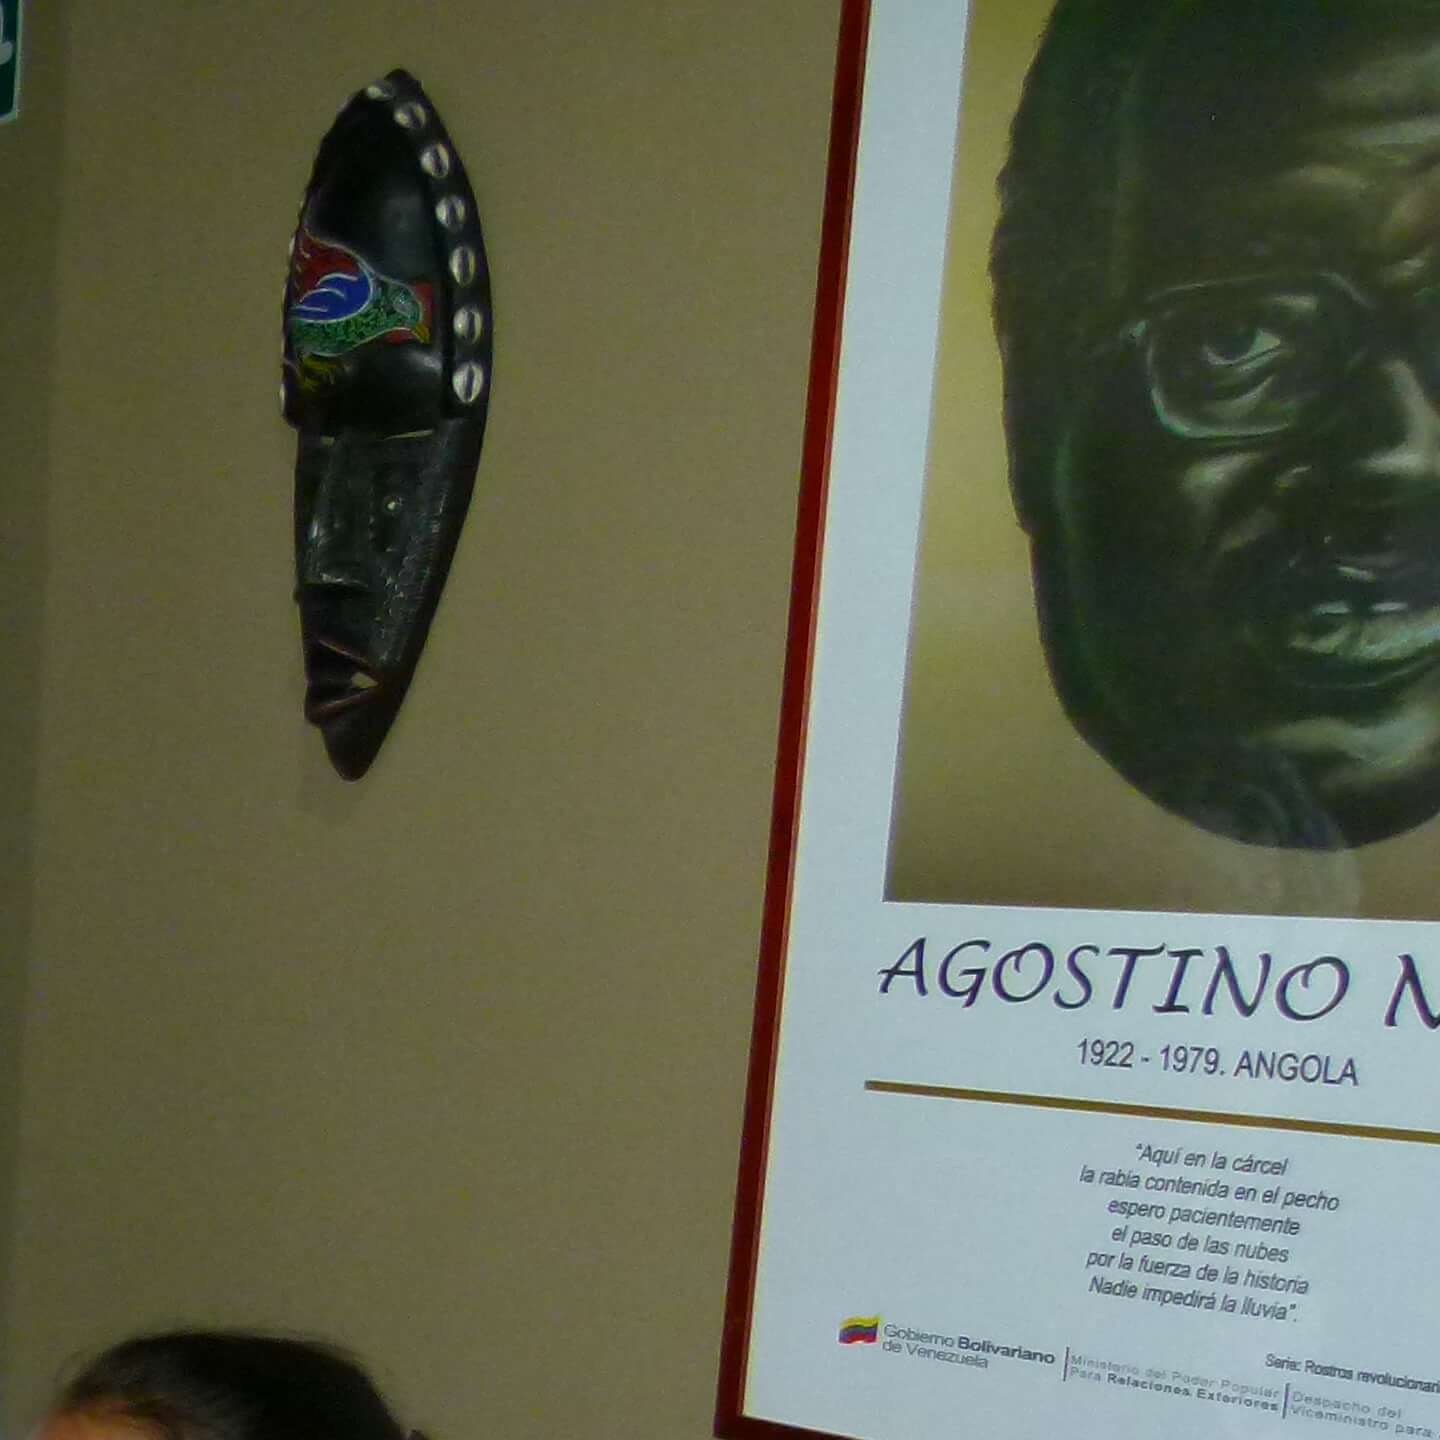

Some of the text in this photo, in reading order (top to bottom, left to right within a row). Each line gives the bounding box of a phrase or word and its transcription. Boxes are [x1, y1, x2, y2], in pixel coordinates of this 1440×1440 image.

[877, 936, 1352, 1021] AGOSTINO
[1077, 1038, 1135, 1069] 1922
[1160, 1044, 1225, 1076] 1979.
[1233, 1050, 1360, 1086] ANGOLA
[1183, 1150, 1206, 1168] en
[1210, 1151, 1227, 1170] la
[1231, 1154, 1289, 1177] cárcel
[1079, 1165, 1340, 1213] la rabia contenida en el pecho
[1107, 1198, 1301, 1236] espero pacientemente
[1111, 1225, 1290, 1264] el paso de las nubes
[1085, 1251, 1310, 1296] por la fuerza de la historia
[1088, 1275, 1138, 1299] Nadie
[1142, 1284, 1216, 1311] impedirá
[1220, 1293, 1237, 1314] la
[882, 1340, 989, 1369] de Venezuela
[883, 1323, 1056, 1365] Gobierno Bolivariano
[1070, 1366, 1279, 1412] Para Relaciones Exteriores
[1221, 1379, 1280, 1399] Popular
[1304, 1360, 1354, 1380] Rostros
[1292, 1391, 1402, 1419] Despacho del
[1394, 1422, 1433, 1439] para
